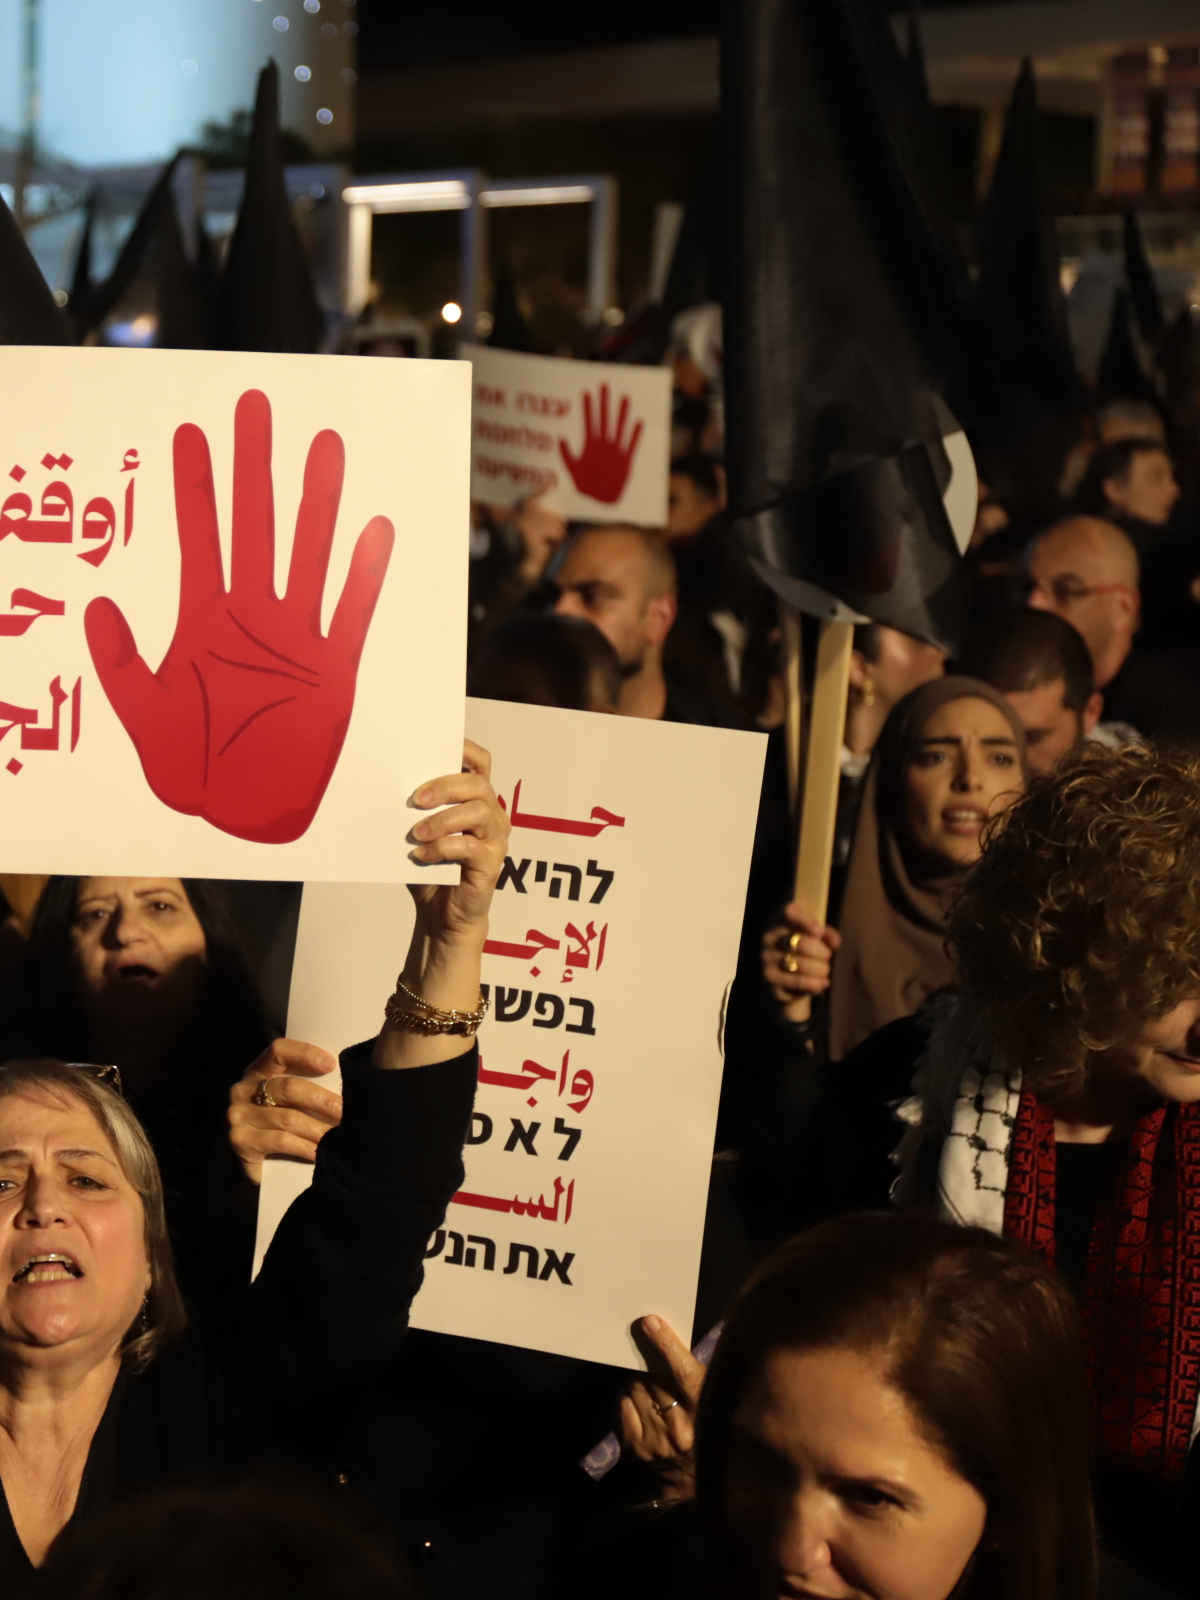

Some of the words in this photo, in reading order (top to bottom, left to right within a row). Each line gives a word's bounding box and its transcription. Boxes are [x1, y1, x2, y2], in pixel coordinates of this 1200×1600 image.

[497, 779, 626, 837] حا
[495, 856, 615, 905] להיא
[482, 920, 608, 983] الإج
[480, 983, 597, 1037] בפש
[477, 1049, 595, 1114] واج
[464, 1112, 582, 1162] לאס
[451, 1176, 575, 1225] الس
[424, 1229, 497, 1272] הנ
[503, 1242, 576, 1286] את
